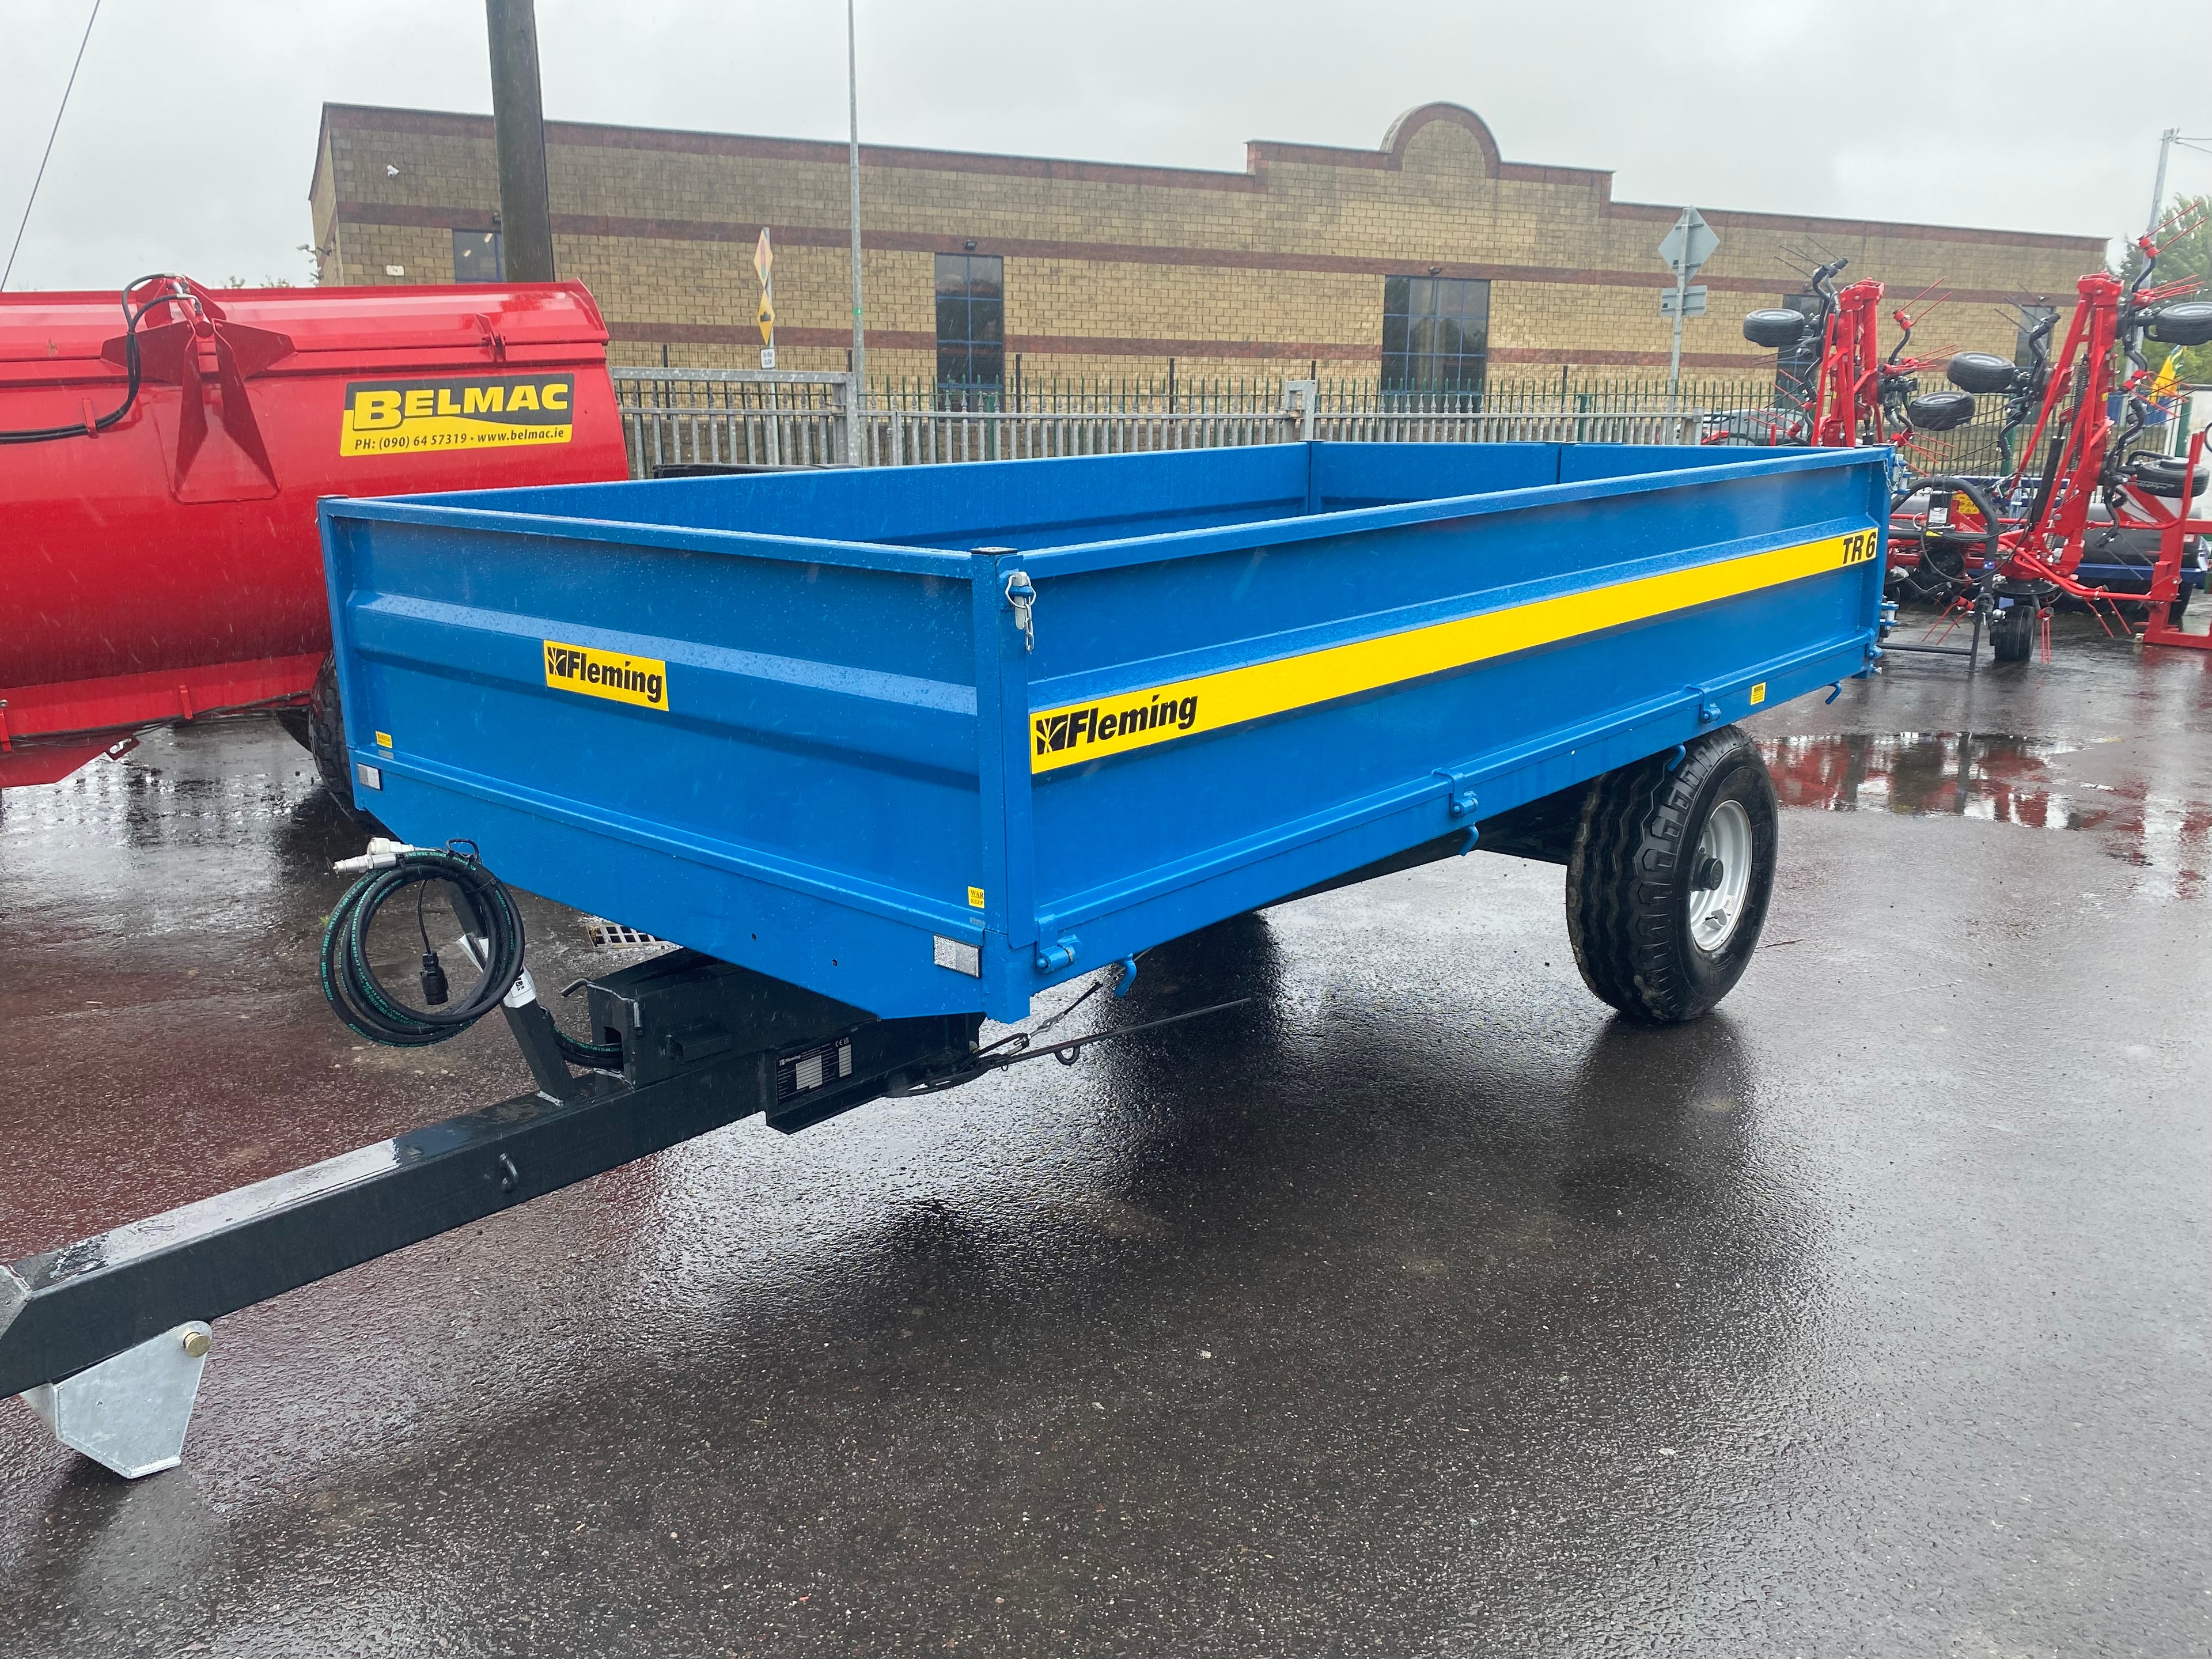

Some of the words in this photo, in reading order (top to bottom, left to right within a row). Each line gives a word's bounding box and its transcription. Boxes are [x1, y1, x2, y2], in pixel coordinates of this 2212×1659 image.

[353, 383, 568, 431] BELMAC
[355, 438, 376, 450] PH:
[379, 436, 410, 450] (090)
[413, 435, 427, 446] 64
[431, 433, 467, 445] 57319
[478, 427, 564, 442] www.belmac.ie
[1843, 535, 1864, 565] TR
[1866, 532, 1877, 558] 6
[567, 651, 662, 703] Fleming
[1066, 694, 1198, 749] Fleming
